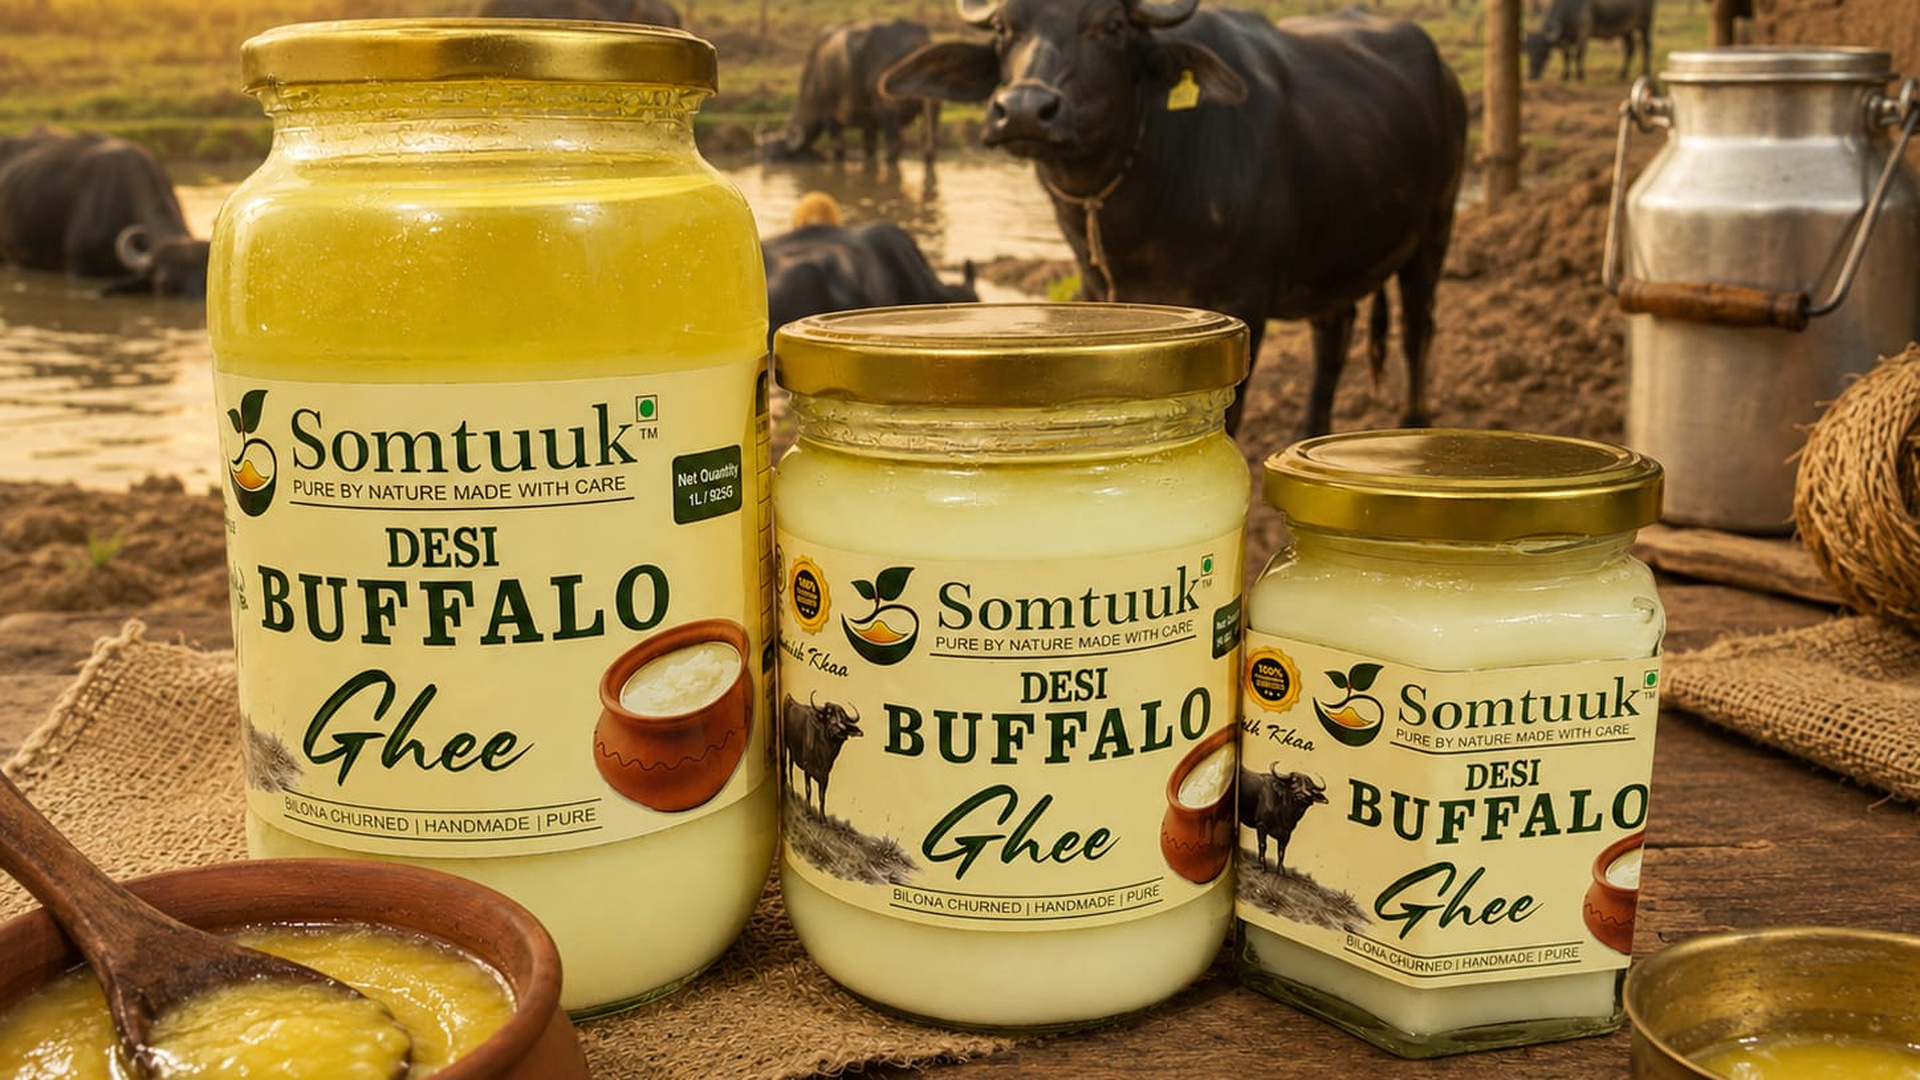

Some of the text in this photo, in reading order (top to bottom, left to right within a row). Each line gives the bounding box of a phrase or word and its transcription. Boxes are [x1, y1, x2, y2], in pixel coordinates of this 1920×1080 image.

[290, 403, 659, 473] Somtuuk TM
[293, 475, 626, 501] PURE BY NATURE MADE WITH CARE
[678, 462, 739, 487] Net Quantity
[689, 492, 702, 506] 1L
[709, 485, 733, 502] 925G
[385, 526, 500, 568] DESI
[258, 564, 670, 646] BUFFALO
[938, 565, 1200, 631] Somtuuk
[936, 620, 1194, 651] PURE BY NATURE MADE WITH CARE
[1020, 667, 1108, 704] DESI
[1258, 663, 1284, 679] 100%
[1398, 676, 1640, 731] Somtuuk
[303, 669, 535, 787] Ghee
[883, 687, 1211, 765] BUFFALO
[1396, 723, 1630, 749] PURE BY NATURE MADE WITH CARE
[1464, 759, 1541, 791] DESI
[284, 796, 328, 821] BILONA
[330, 809, 409, 833] CHURNED
[424, 816, 530, 833] HANDMADE
[546, 807, 596, 828] PURE
[1347, 778, 1648, 845] BUFFALO
[921, 784, 1121, 880] Ghee
[892, 888, 944, 910] BILONA
[947, 898, 1022, 915] CHURNED
[1034, 895, 1116, 915] HANDMADE
[1126, 884, 1160, 904] PURE
[1374, 861, 1544, 940] Ghee
[1346, 934, 1387, 960] BILONA
[1389, 951, 1453, 973] CHURNED
[1462, 952, 1535, 970] HANDMADE
[1544, 947, 1579, 962] PURE
